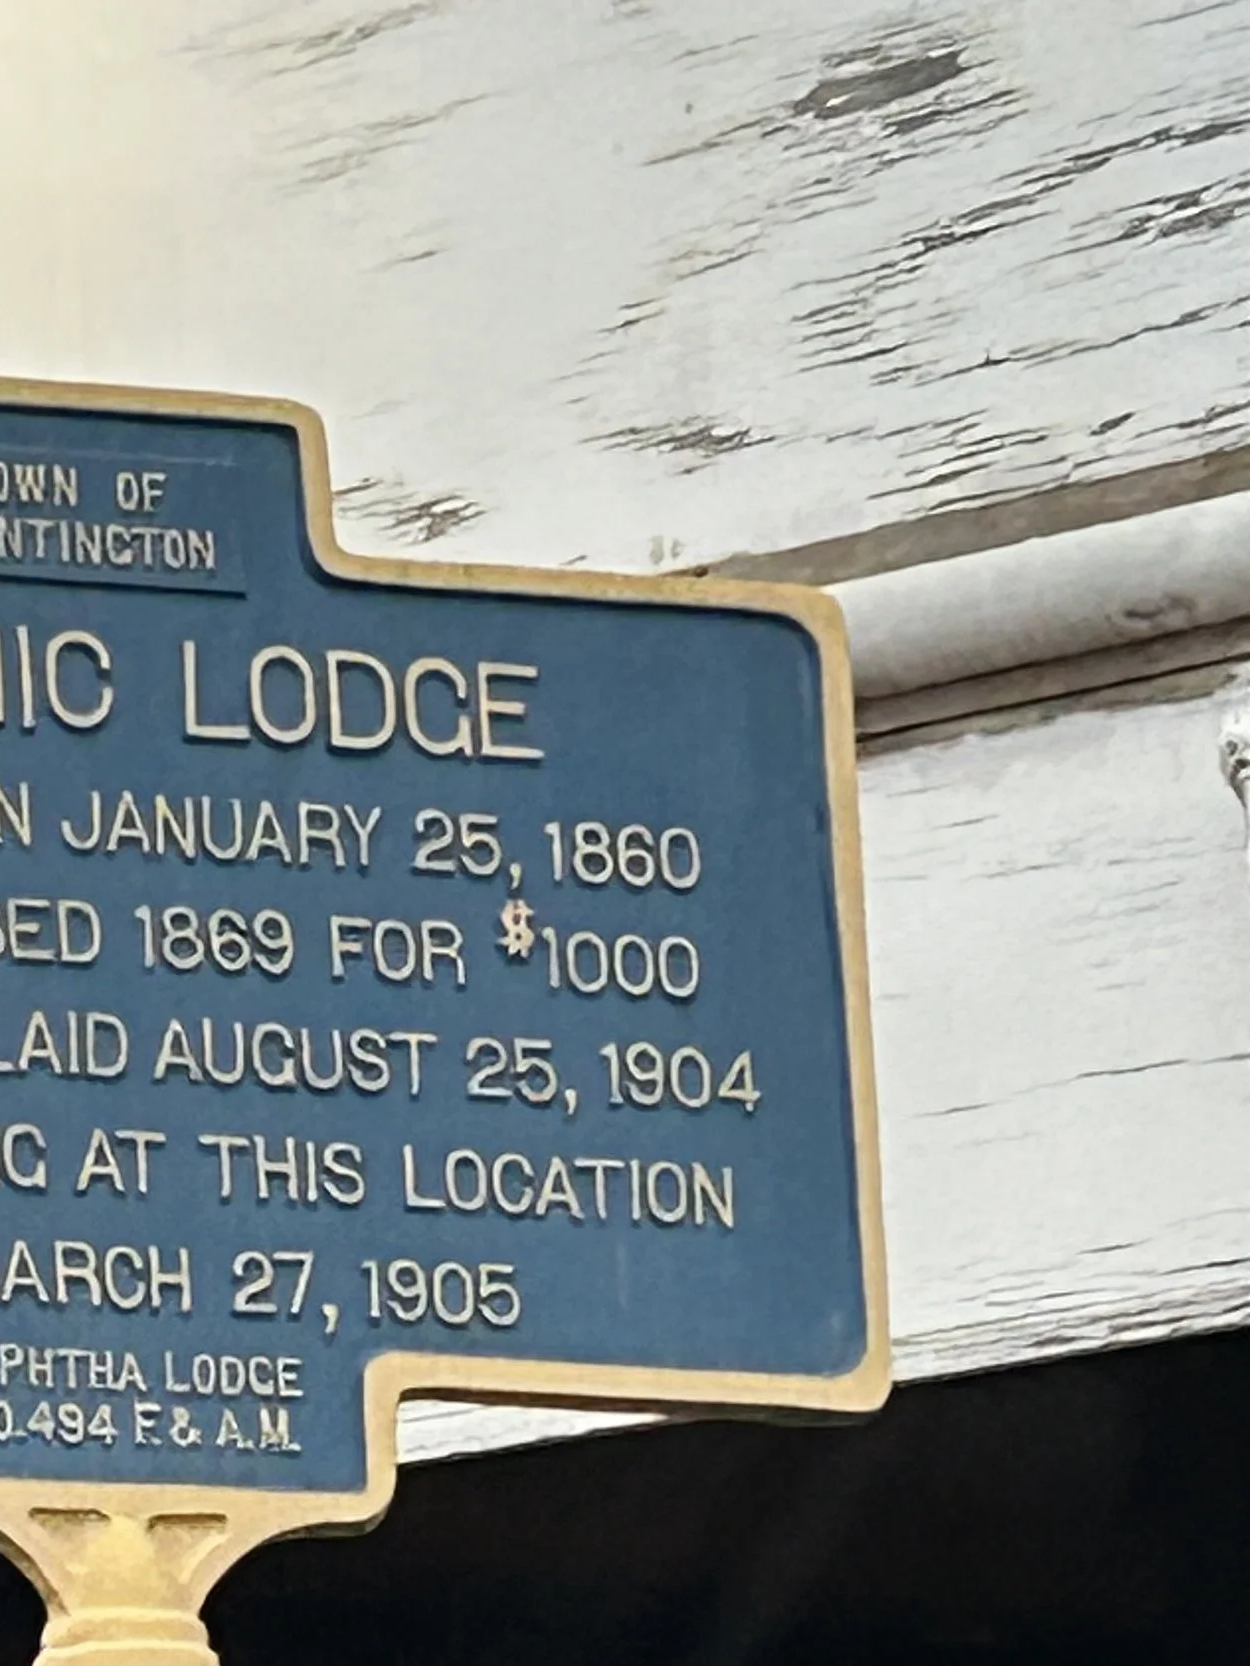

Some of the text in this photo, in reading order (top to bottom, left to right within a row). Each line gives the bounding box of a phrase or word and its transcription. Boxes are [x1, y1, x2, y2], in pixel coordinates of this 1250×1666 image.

[115, 471, 167, 511] OF
[182, 639, 546, 759] LODGE
[60, 789, 382, 867] JANUARY
[412, 807, 523, 889] 25,
[543, 820, 702, 889] 1860
[133, 904, 295, 975] 1869
[329, 914, 467, 985] FOR
[497, 898, 700, 998] $1000
[153, 1016, 439, 1094] AUGUST
[465, 1036, 578, 1116] 25,
[599, 1040, 762, 1112] 1904
[76, 1127, 168, 1194] AT
[197, 1133, 366, 1205] THIS
[401, 1143, 735, 1229] LOCATION
[231, 1250, 340, 1335] 27,
[361, 1257, 522, 1326] 1905
[164, 1350, 305, 1398] LODGE
